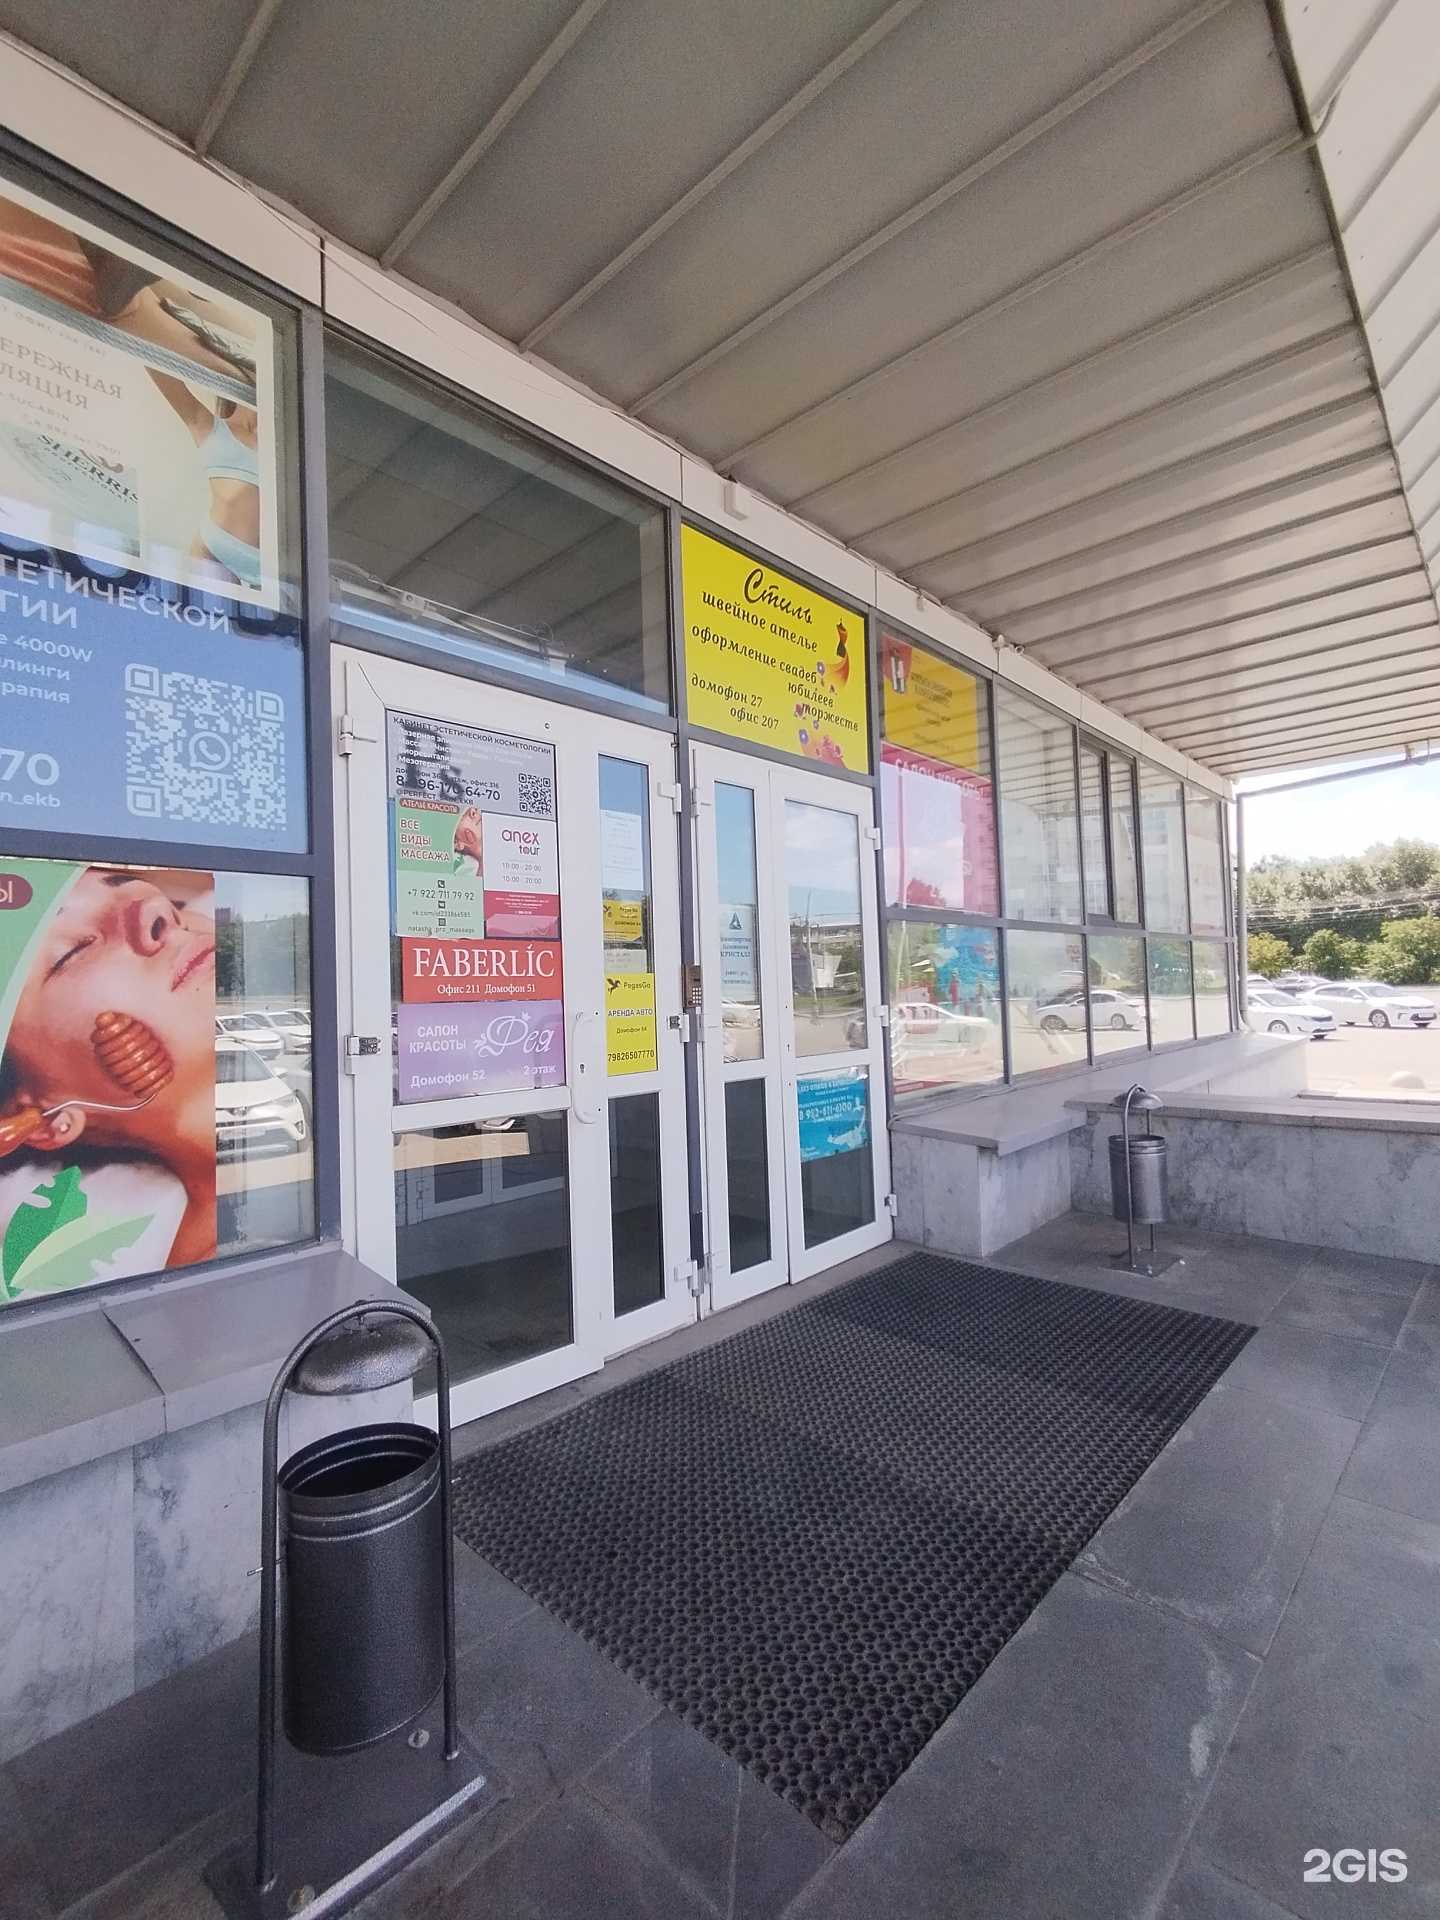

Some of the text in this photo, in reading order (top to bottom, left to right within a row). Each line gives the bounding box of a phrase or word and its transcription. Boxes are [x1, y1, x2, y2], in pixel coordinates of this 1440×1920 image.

[744, 568, 813, 625] Стиль
[702, 591, 818, 652] швейное ателье
[14, 635, 93, 662] 4000W
[691, 624, 817, 684] оформление свадеб
[691, 673, 763, 709] домофон 27
[788, 682, 834, 708] юбилеев
[730, 707, 779, 730] офис 207
[801, 703, 859, 732] торжеств
[393, 716, 432, 730] КАБИНЕТ
[433, 726, 493, 744] ЭСТЕТИЧЕСКОЙ
[493, 739, 551, 754] КОСМЕТОЛОГИИ
[400, 819, 419, 830] ВСЕ
[400, 834, 432, 847] ВИДЫ
[501, 829, 540, 845] anex
[400, 849, 450, 861] МАССАЖА
[519, 845, 540, 856] tour
[408, 888, 475, 901] +7 922 711 79 92
[437, 983, 536, 996] Офис 211 Домофон 51
[608, 1008, 654, 1017] АРЕНДА АВТО
[417, 1024, 459, 1038] САЛОН
[474, 1015, 555, 1058] Фея
[409, 1039, 467, 1054] КРАСОТЫ
[523, 1063, 557, 1076] 2 этаж
[410, 1069, 487, 1089] Домофон 52
